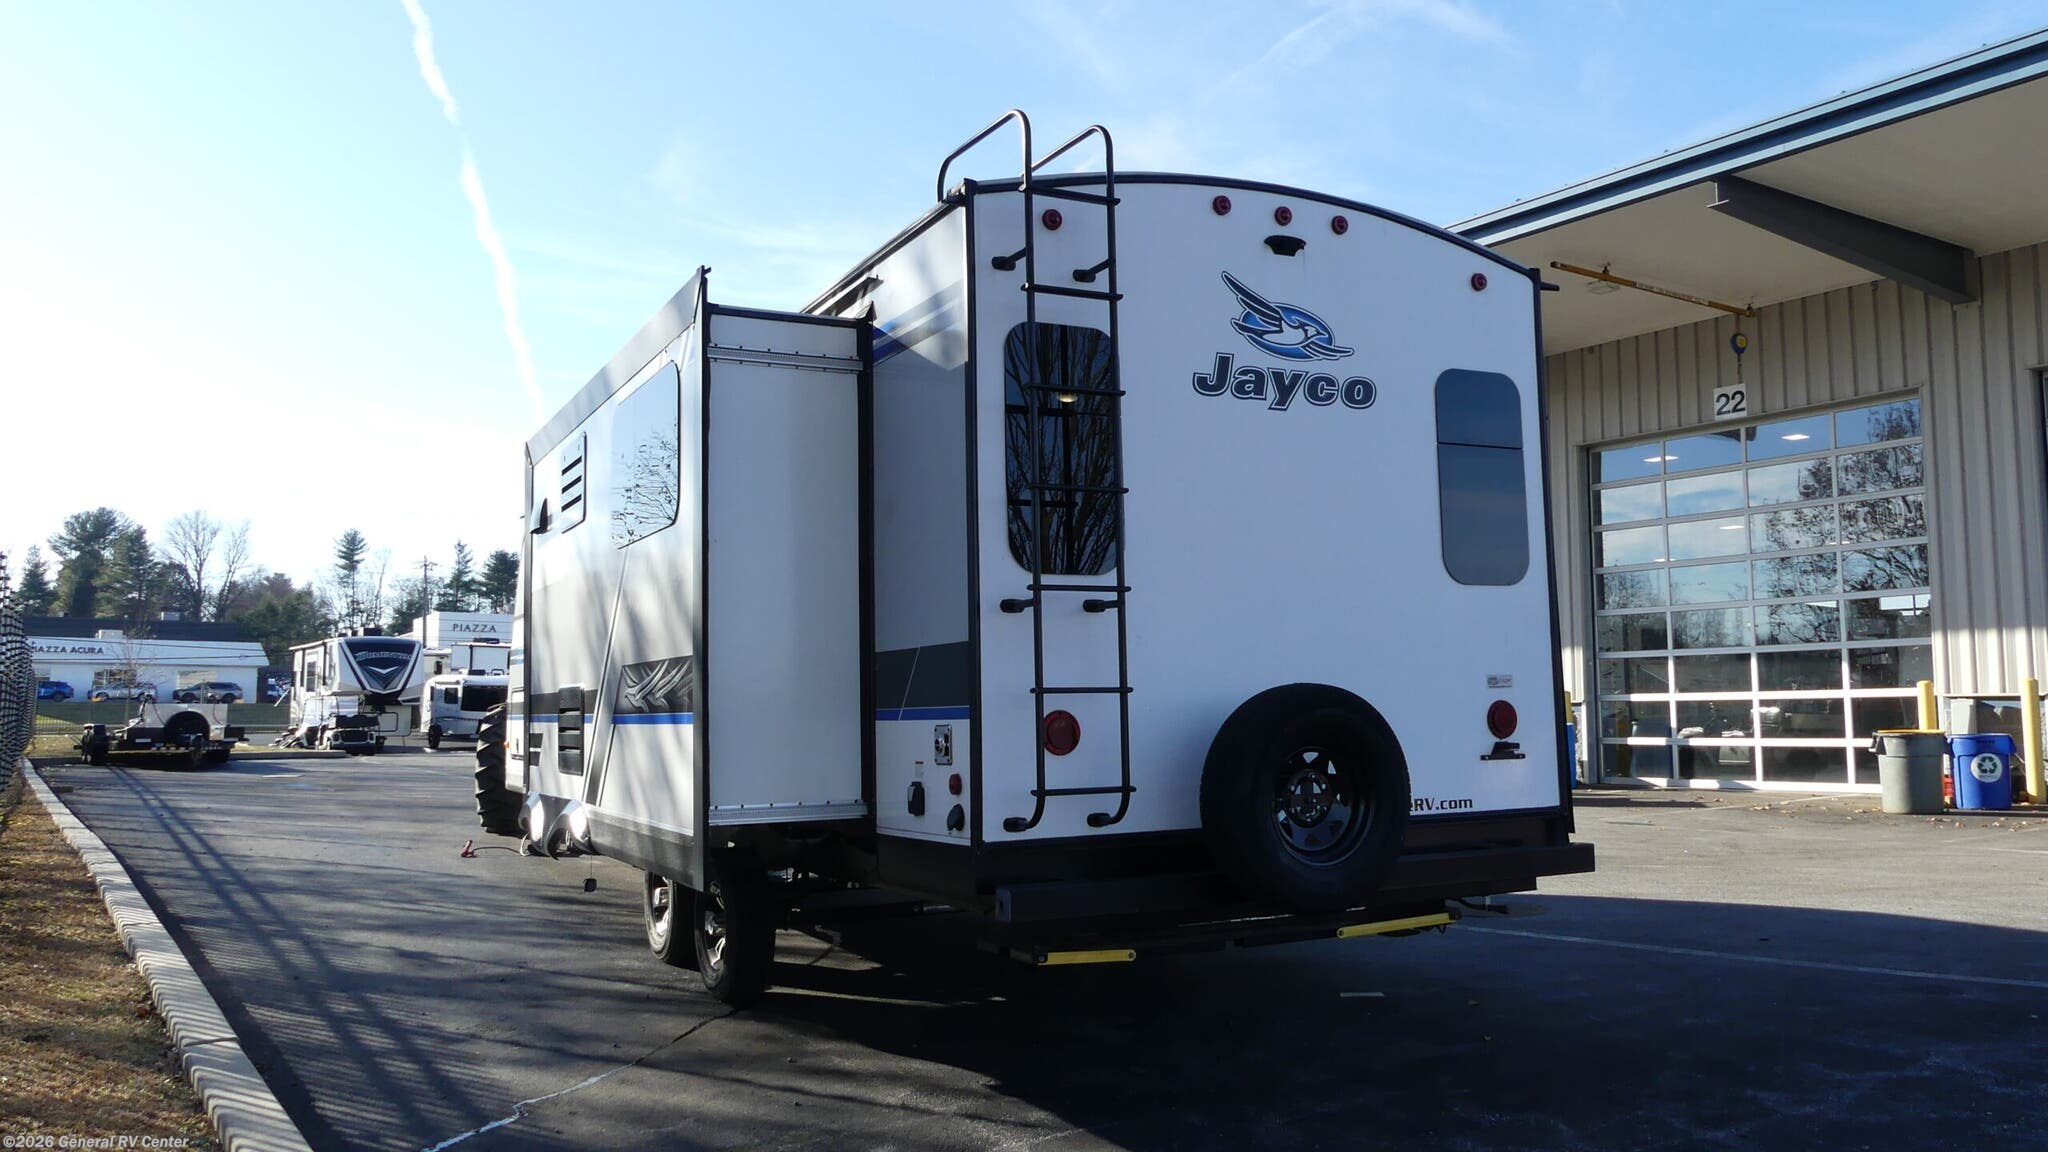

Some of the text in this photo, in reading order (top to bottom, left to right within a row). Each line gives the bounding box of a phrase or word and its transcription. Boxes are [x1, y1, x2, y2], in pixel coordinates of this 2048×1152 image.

[1192, 352, 1377, 411] Jayco
[1715, 390, 1746, 416] 22
[452, 623, 497, 633] PIAZZA
[32, 645, 105, 655] IAZZA ACURA
